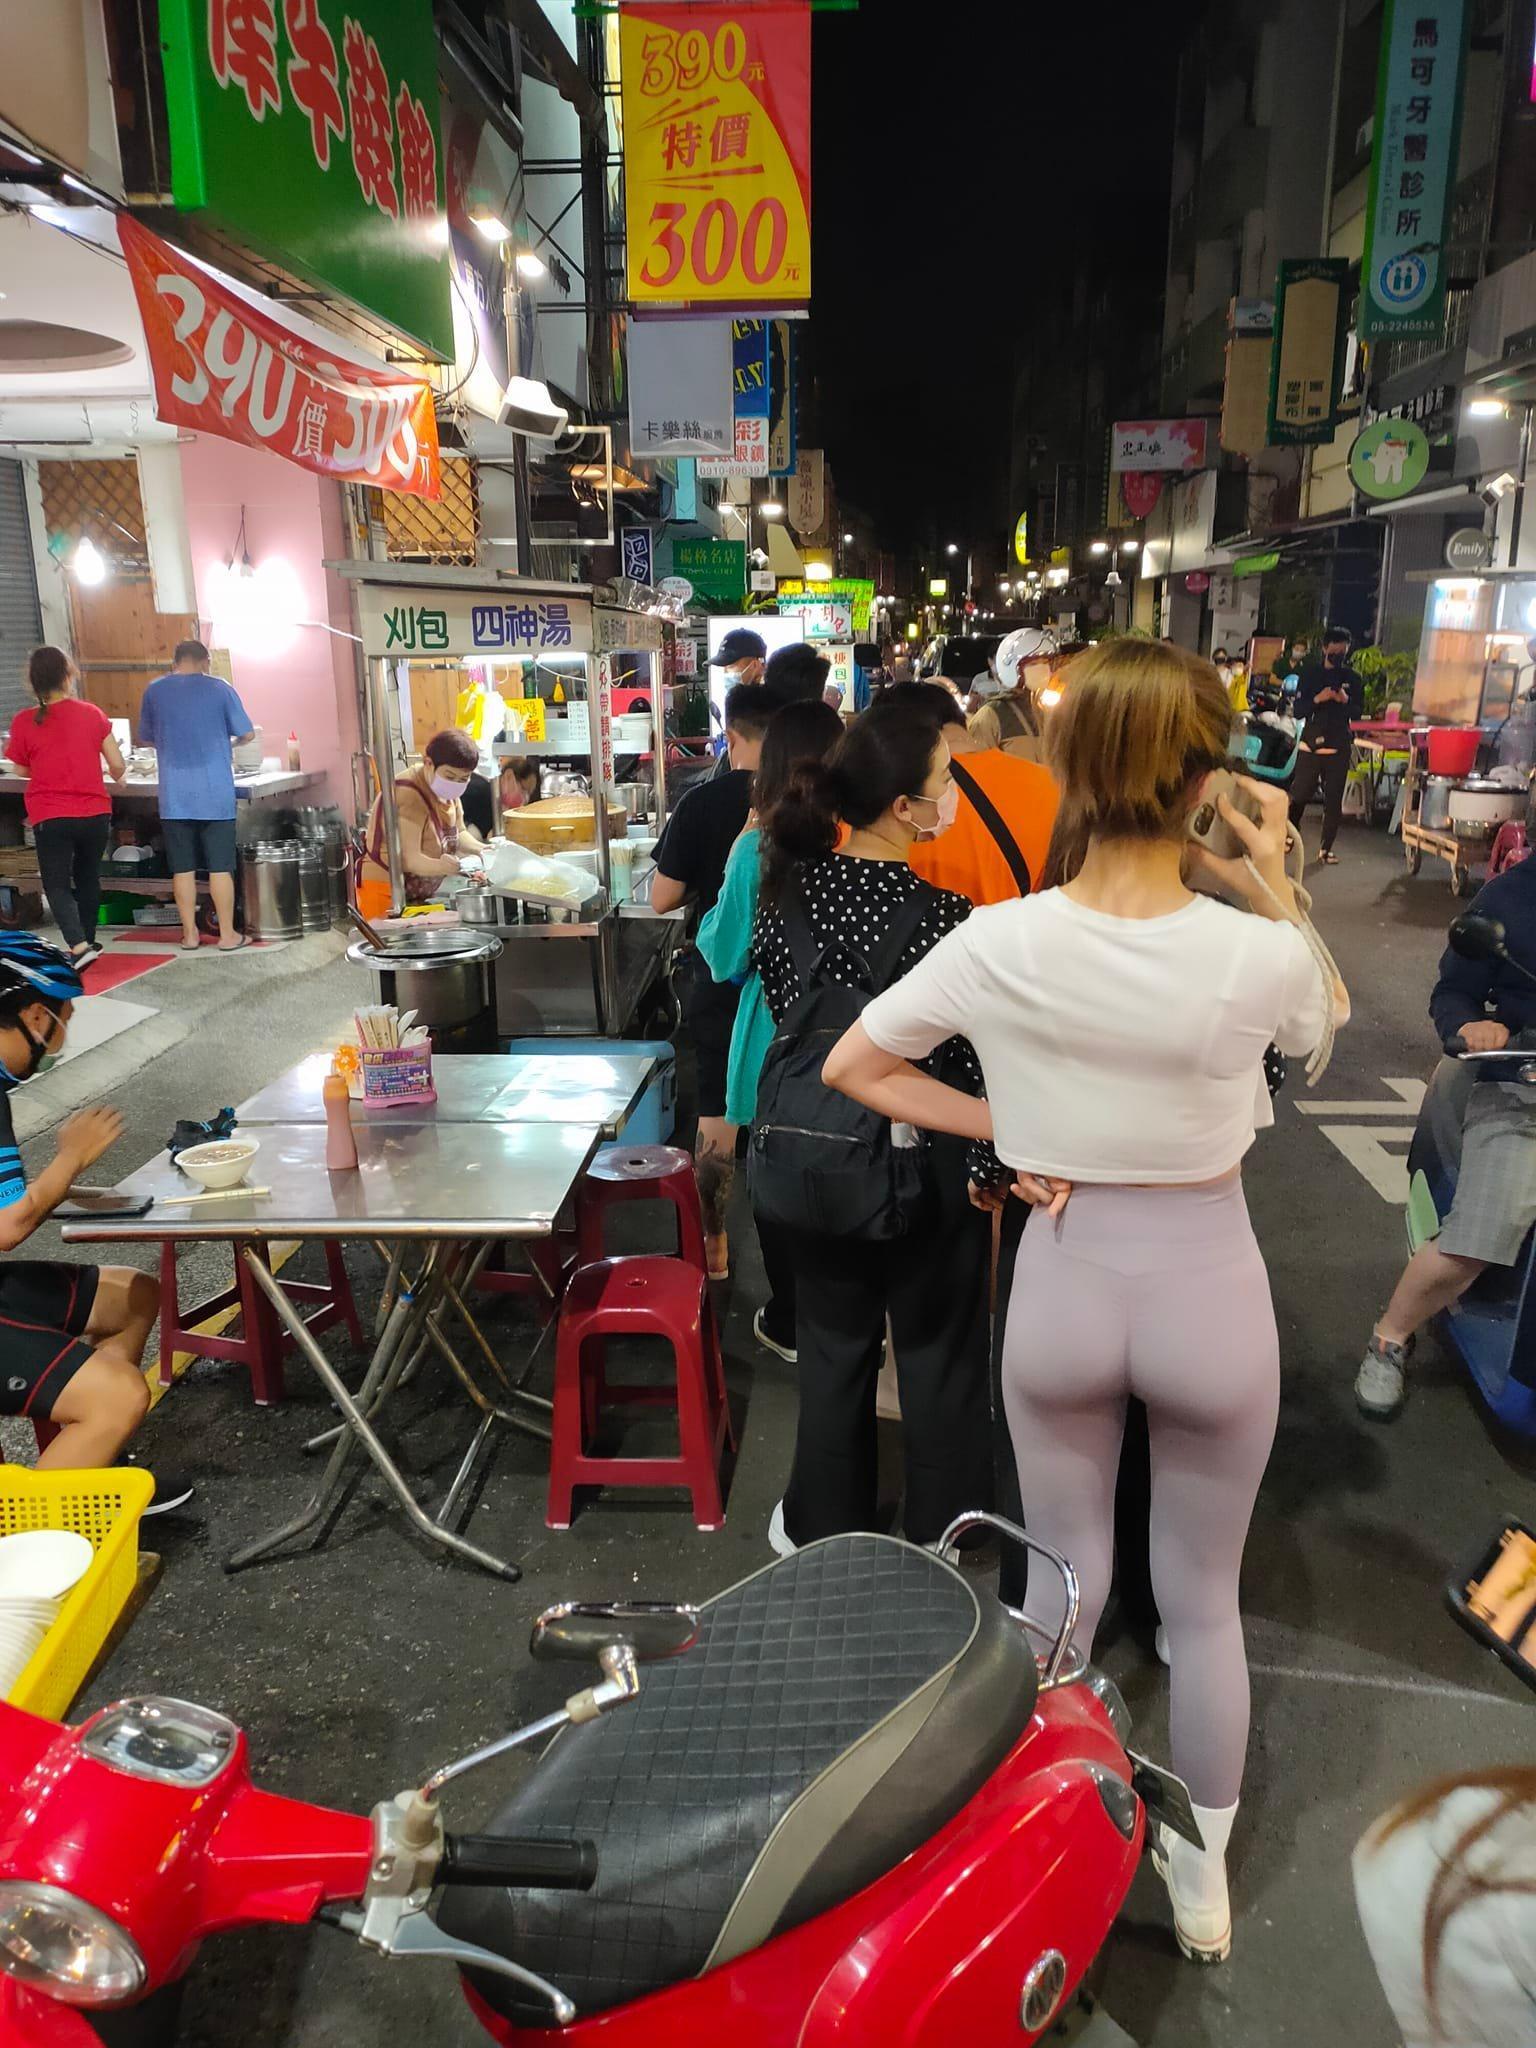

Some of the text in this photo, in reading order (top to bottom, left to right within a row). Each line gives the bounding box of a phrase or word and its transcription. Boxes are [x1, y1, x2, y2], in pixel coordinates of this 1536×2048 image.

[660, 111, 752, 171] 特價
[1396, 18, 1439, 236] 馬可牙醫診所
[156, 274, 297, 438] 390
[1453, 542, 1485, 557] Emily
[383, 606, 450, 650] 刈包
[471, 603, 573, 648] 四神湯
